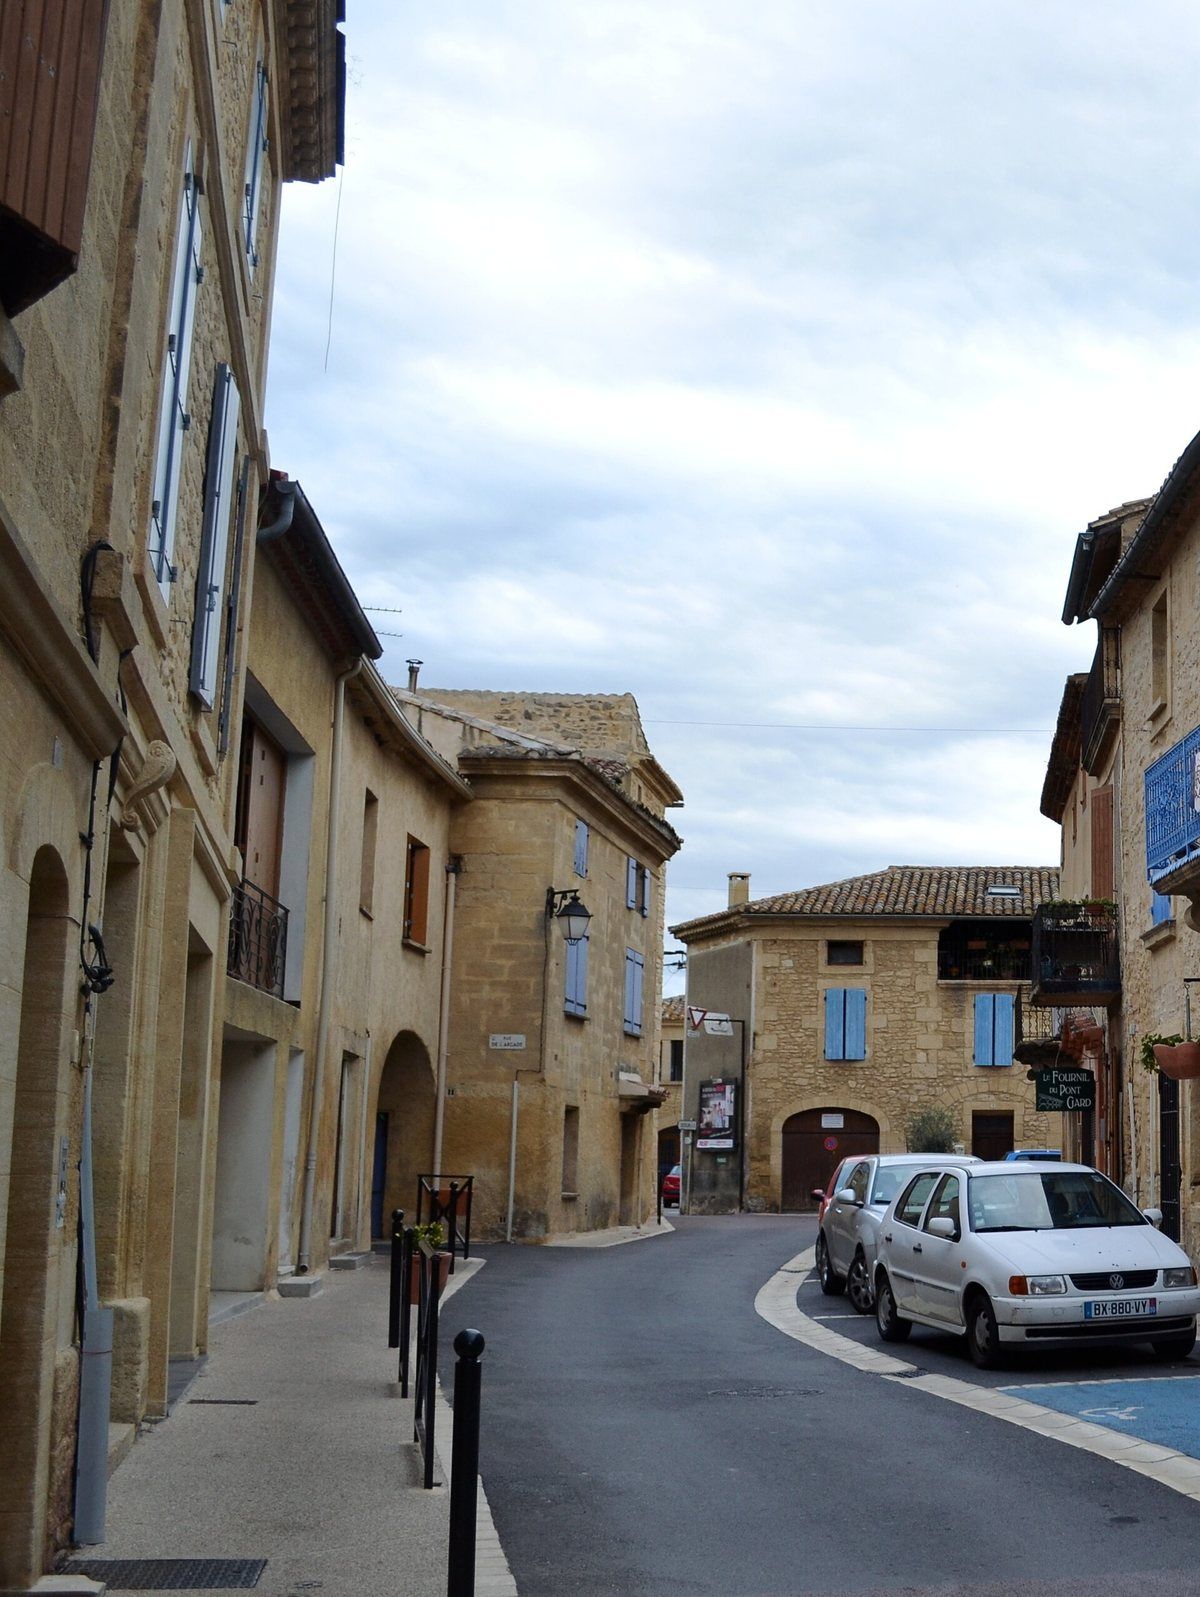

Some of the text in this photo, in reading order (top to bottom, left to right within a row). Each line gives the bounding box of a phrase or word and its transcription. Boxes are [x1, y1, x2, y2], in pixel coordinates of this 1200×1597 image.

[1052, 1070, 1090, 1084] FOURNIL
[1060, 1084, 1081, 1096] PONT
[1066, 1096, 1092, 1109] GARD
